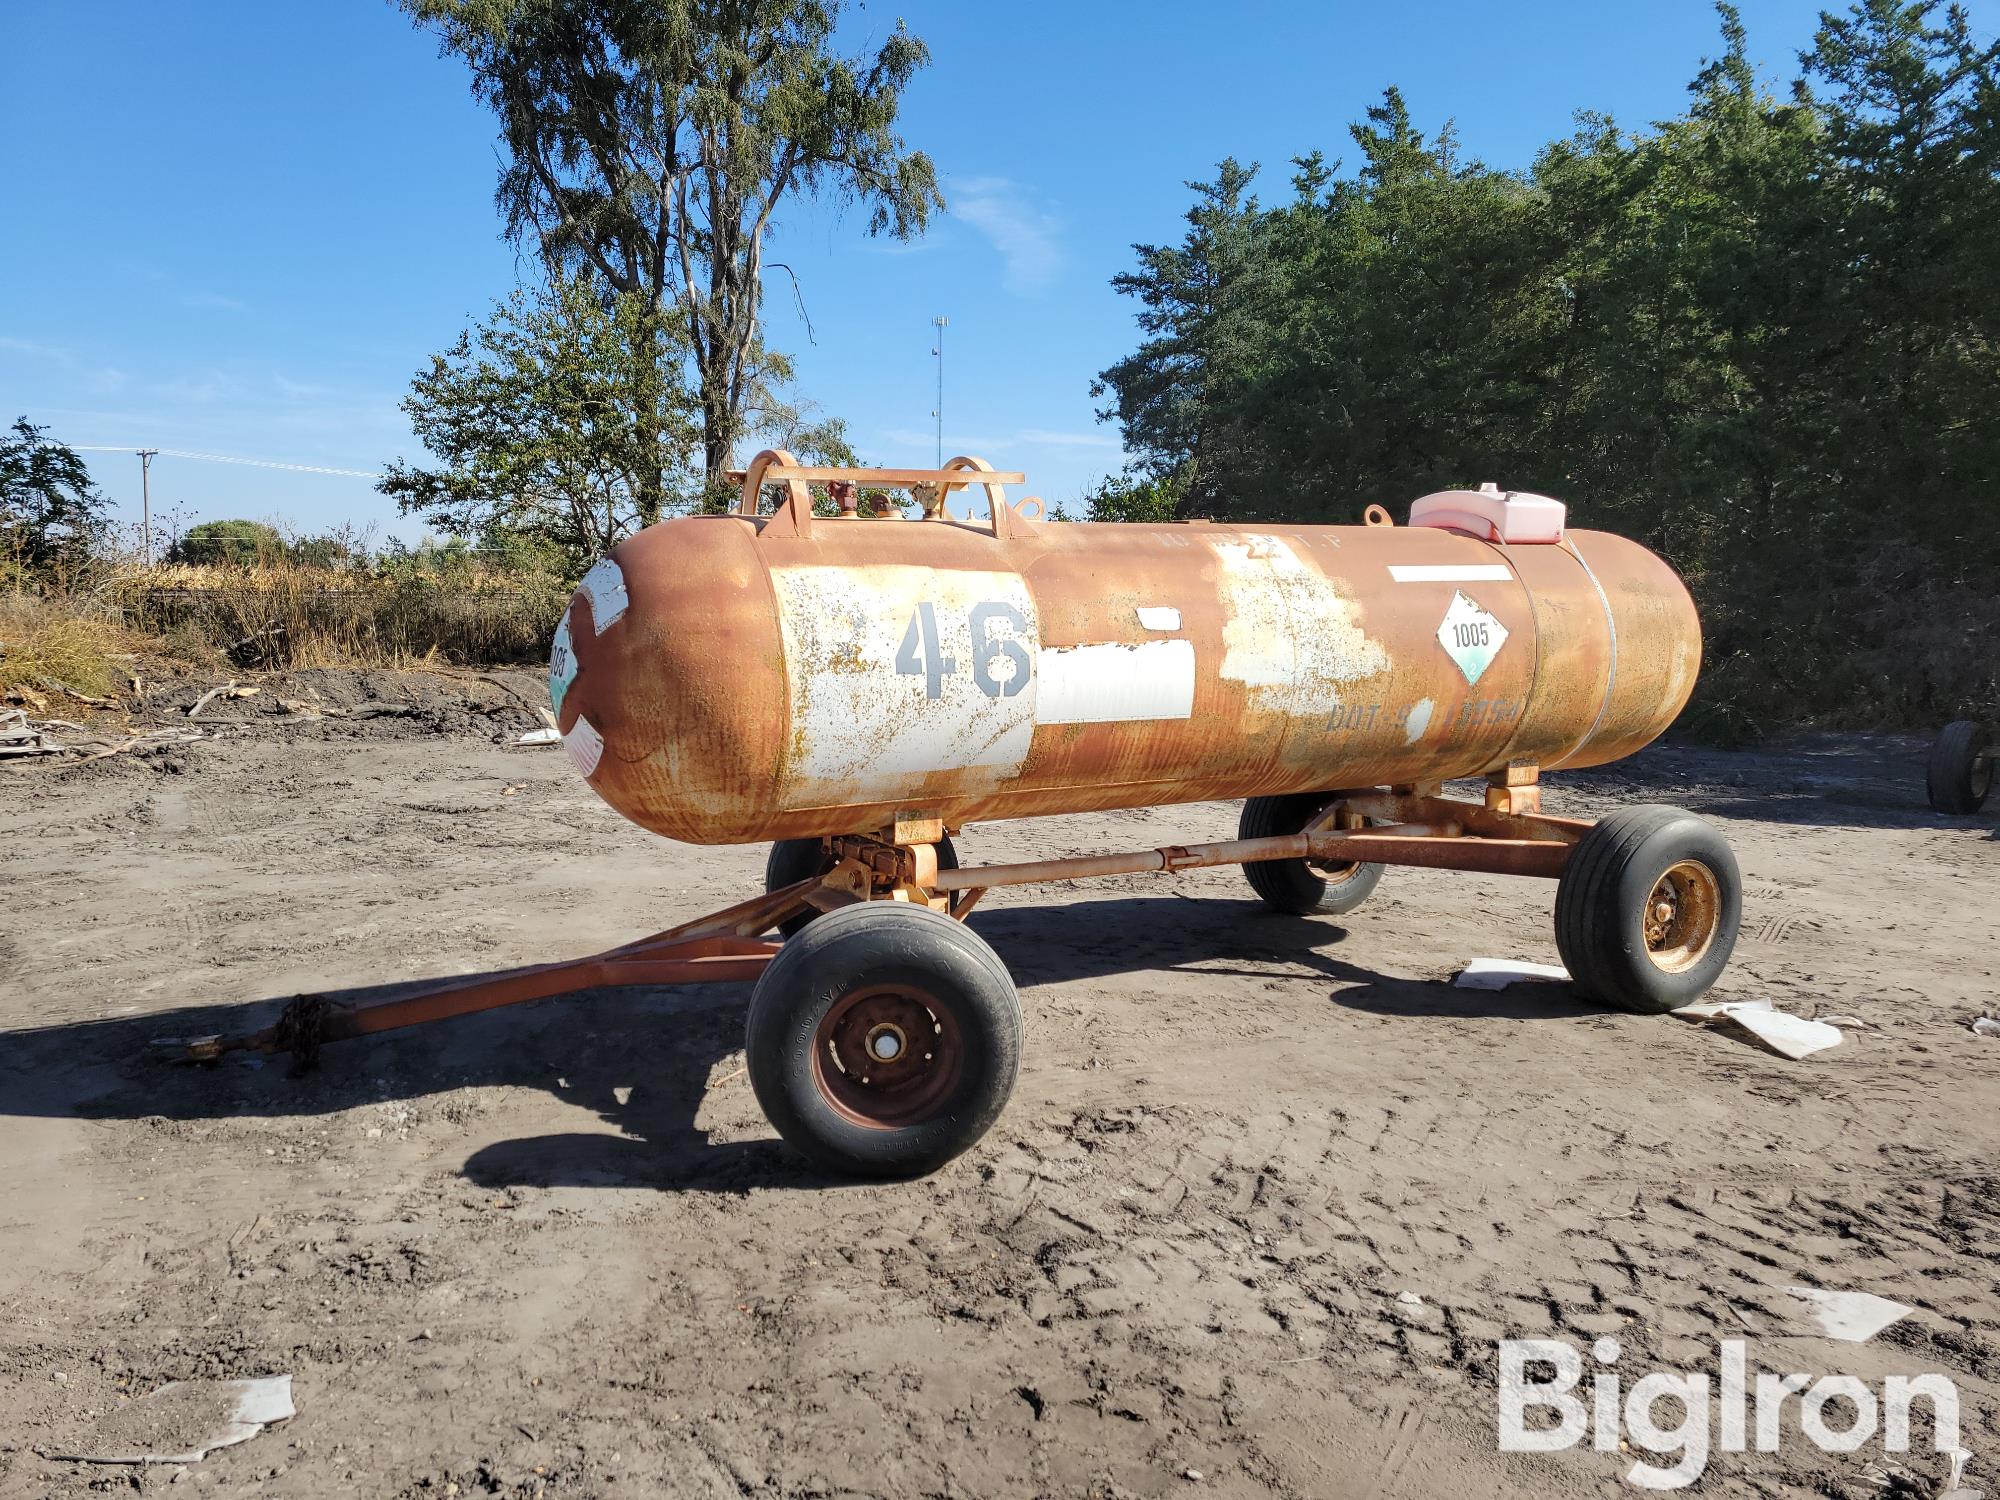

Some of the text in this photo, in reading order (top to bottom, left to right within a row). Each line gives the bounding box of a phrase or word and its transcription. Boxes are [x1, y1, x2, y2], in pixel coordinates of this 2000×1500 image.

[1452, 622, 1490, 648] 1005
[894, 601, 1031, 700] 46
[1469, 663, 1477, 675] 2
